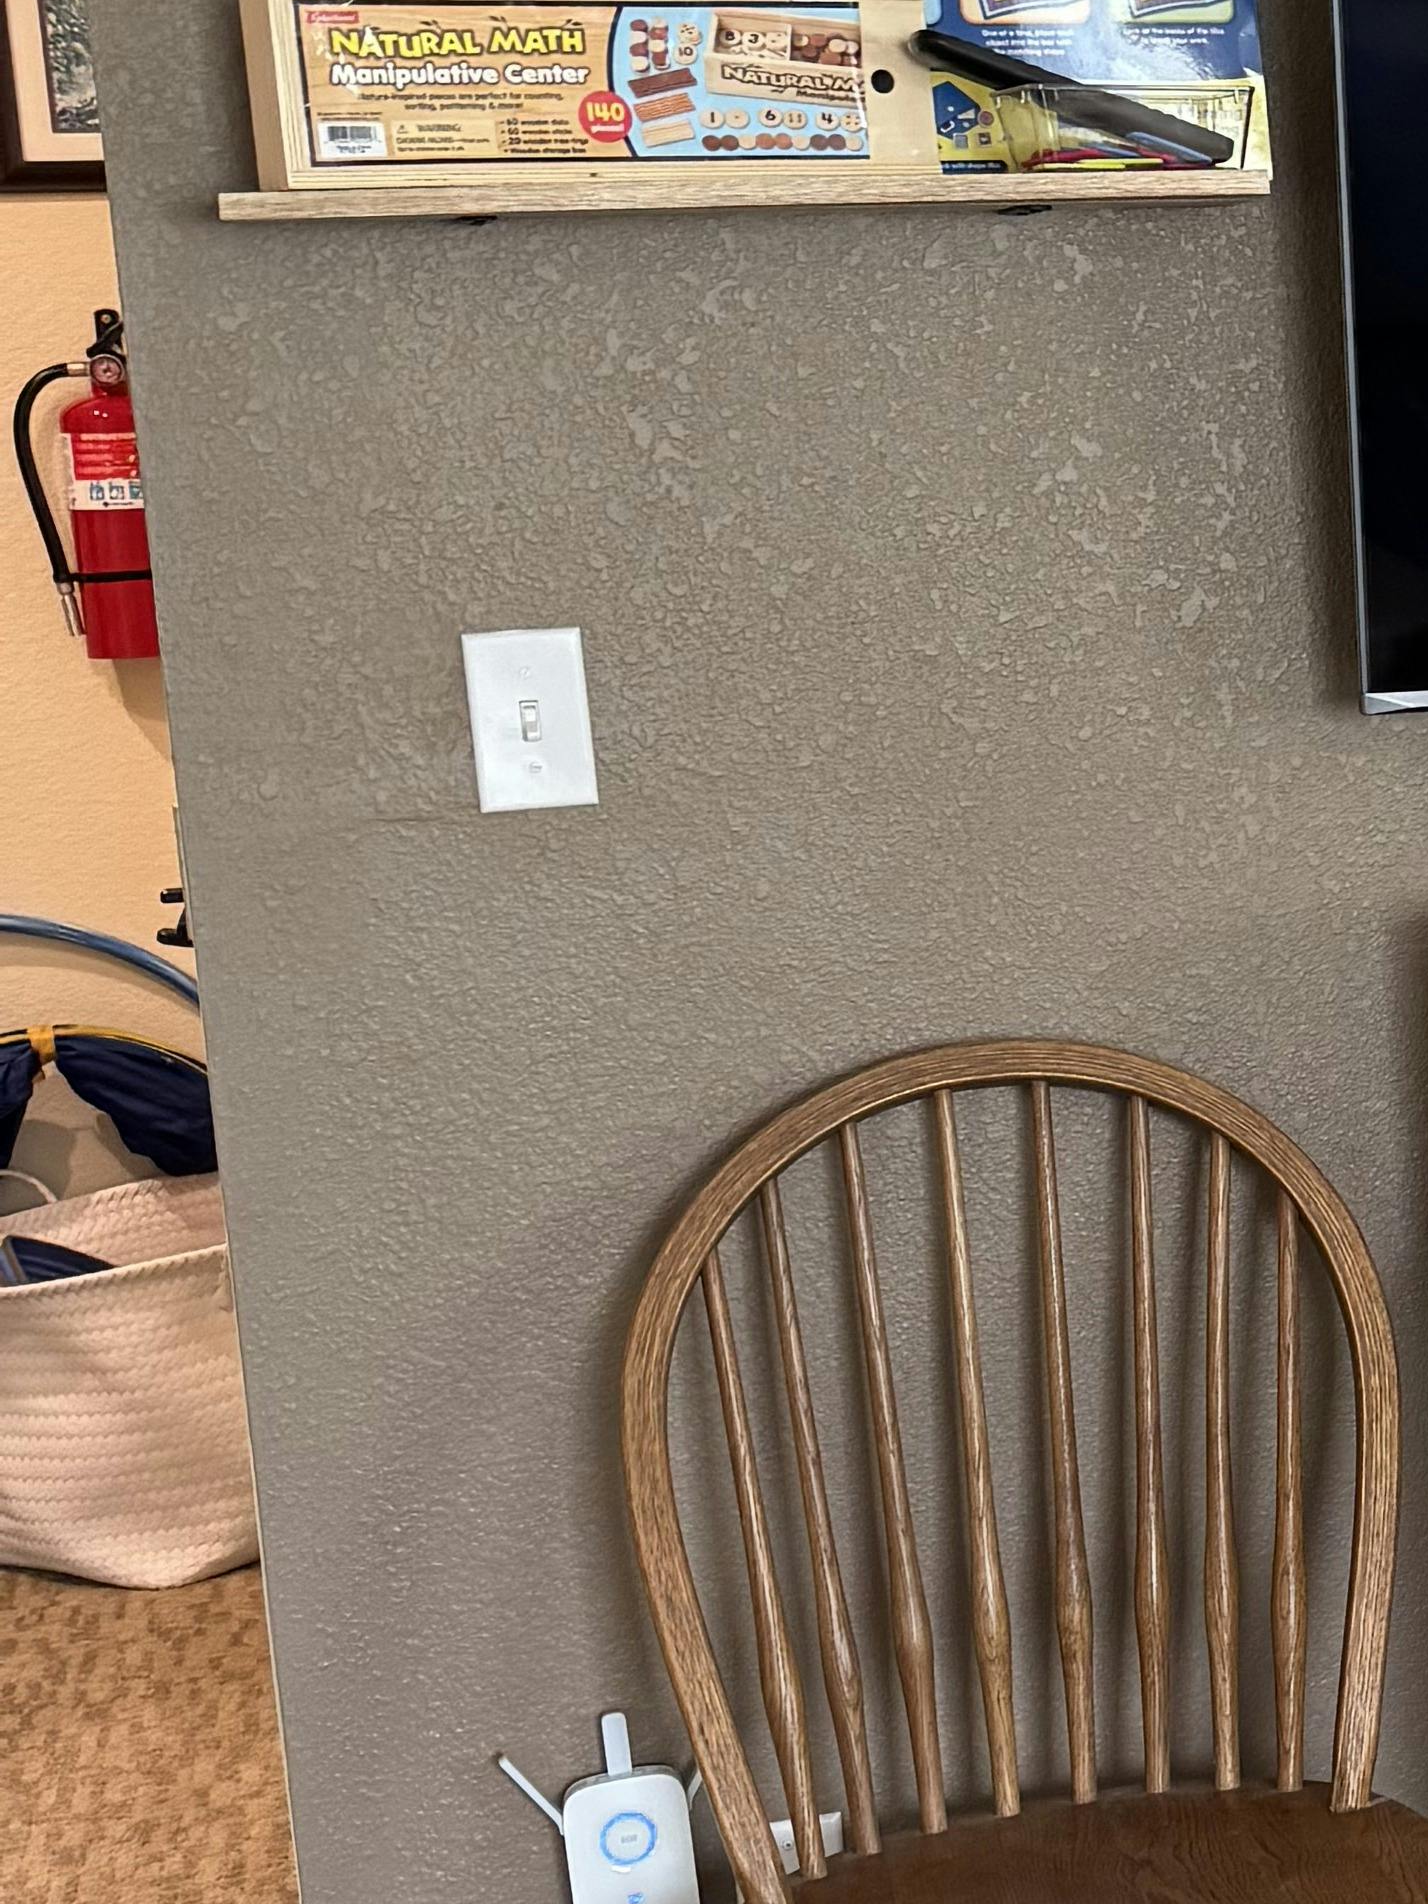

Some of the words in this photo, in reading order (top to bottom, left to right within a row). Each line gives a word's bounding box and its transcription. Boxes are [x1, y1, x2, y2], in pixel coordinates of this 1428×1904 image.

[329, 26, 483, 58] NATURAL
[490, 26, 585, 55] MATH
[679, 45, 693, 57] 10
[331, 62, 499, 89] Manipulative
[503, 63, 590, 86] Center
[722, 64, 827, 90] NATURAL
[586, 102, 625, 122] 140
[765, 109, 776, 121] 6
[821, 113, 833, 124] 4
